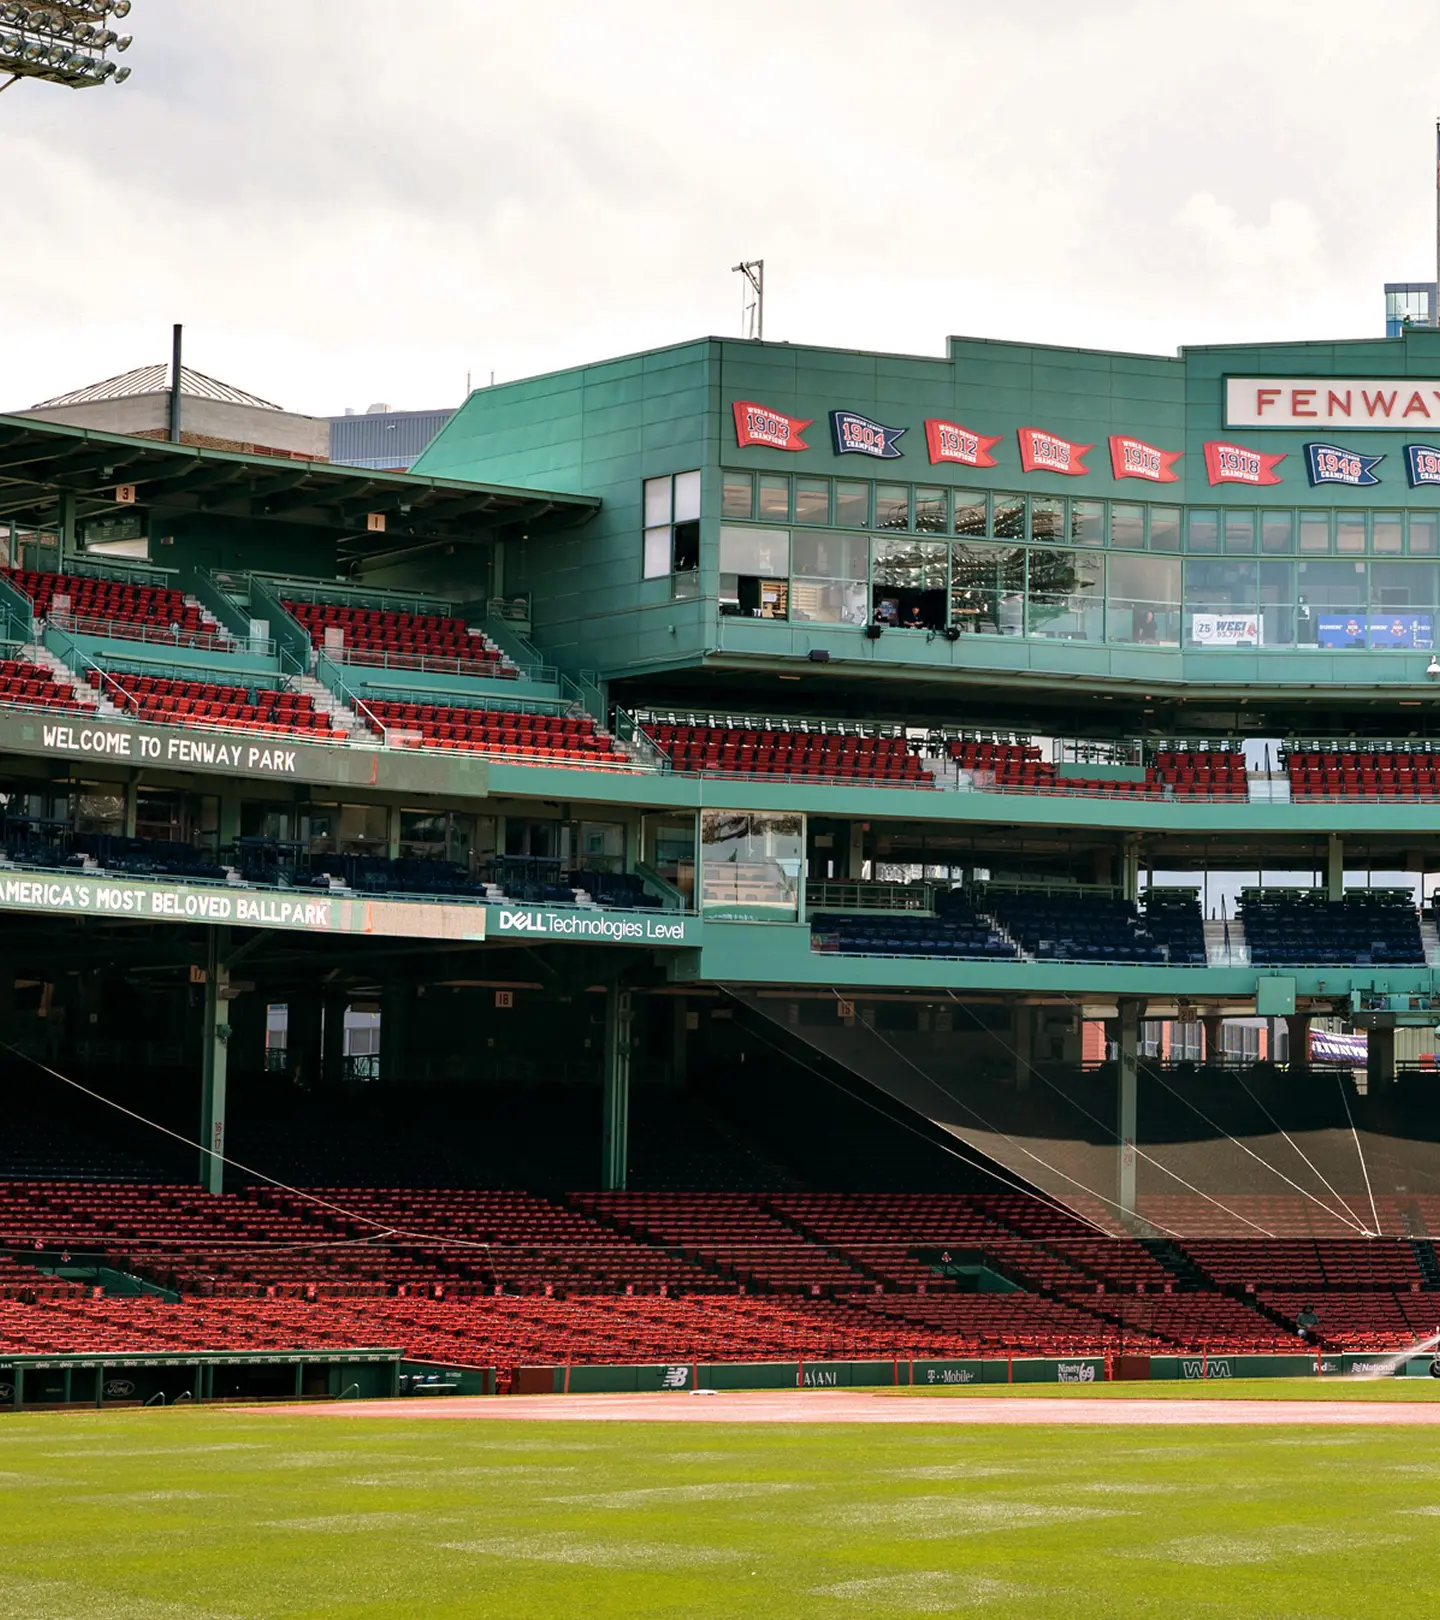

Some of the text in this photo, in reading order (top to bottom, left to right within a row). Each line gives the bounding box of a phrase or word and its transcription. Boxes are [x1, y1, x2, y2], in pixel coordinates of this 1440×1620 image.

[747, 407, 767, 417] WORLD
[747, 414, 789, 440] 1903
[939, 424, 958, 434] WORLD
[750, 431, 787, 446] CHAMPIONS
[842, 422, 885, 449] 1904
[1031, 432, 1051, 441] WORLD
[846, 440, 883, 455] CHAMPIONS
[940, 432, 978, 457] 1912
[1032, 439, 1070, 464] 1915
[1123, 441, 1142, 450] WORLD
[1218, 446, 1239, 455] WORLD
[941, 449, 977, 463] CHAMPIONS
[1124, 448, 1160, 472] 1916
[1219, 452, 1260, 474] 1918
[1034, 456, 1069, 471] CHAMPIONS
[1318, 454, 1362, 477] 1946
[1125, 464, 1159, 478] CHAMPIONS
[1220, 469, 1259, 481] CHAMPIONS
[1321, 471, 1359, 483] CHAMPIONS
[122, 488, 129, 500] 3
[1216, 621, 1247, 631] WEEI
[43, 725, 296, 772] WELCOME TO FENWAY PARK
[0, 881, 327, 925] AMERICA'S MOST BELOVED BALLPARK
[499, 911, 684, 940] DELL Technologies Level
[499, 993, 509, 1005] 18
[1181, 1010, 1193, 1021] 20
[1058, 1363, 1079, 1374] Ninety
[1183, 1361, 1231, 1378] WM
[1362, 1363, 1396, 1372] National
[796, 1368, 837, 1387] ASANI
[1058, 1373, 1079, 1382] Nine
[107, 1383, 128, 1394] Ford
